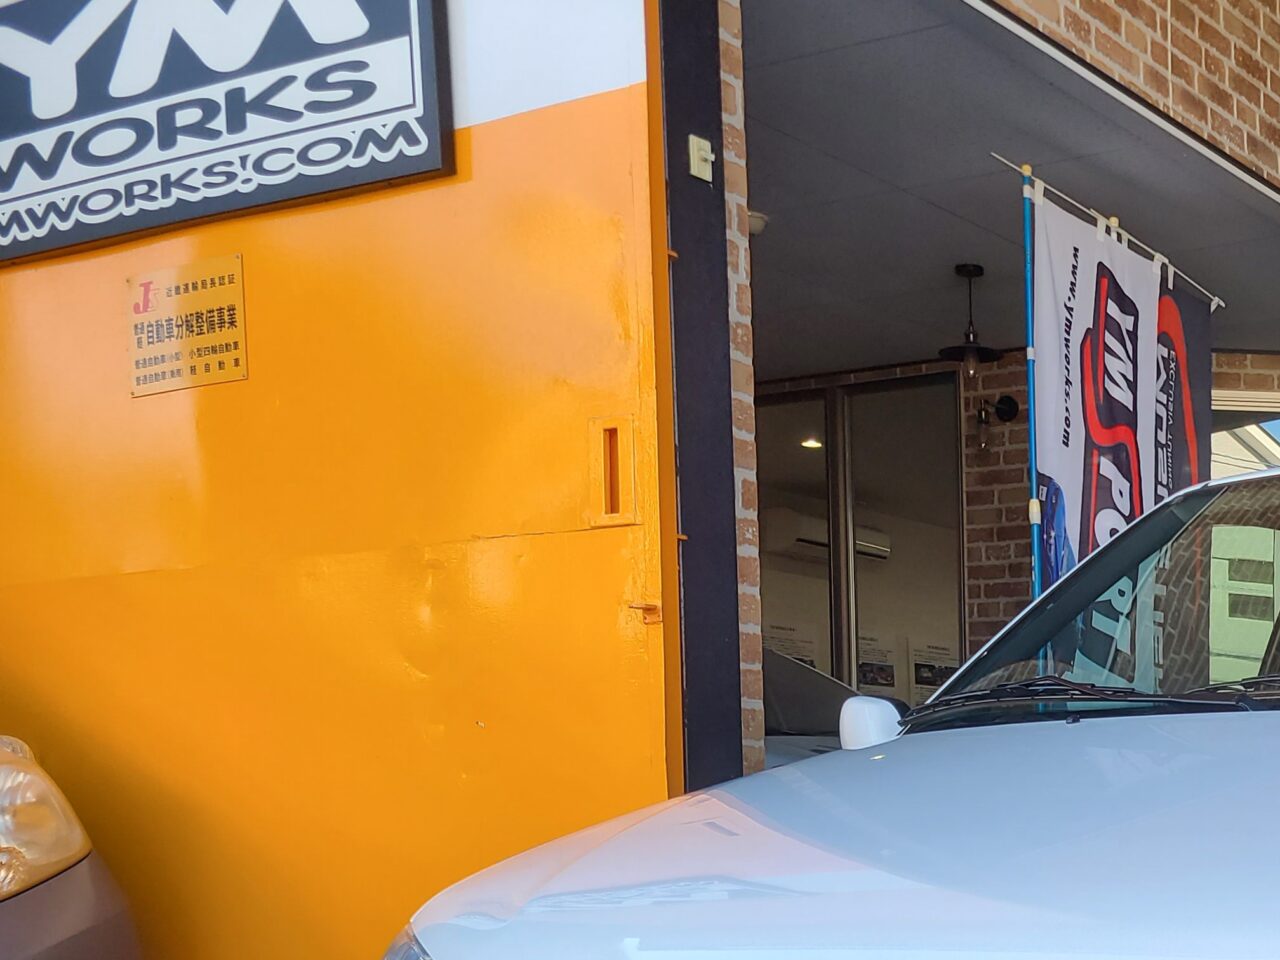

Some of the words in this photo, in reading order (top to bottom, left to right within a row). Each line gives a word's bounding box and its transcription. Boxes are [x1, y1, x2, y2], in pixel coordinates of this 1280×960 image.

[0, 60, 377, 192] WORKS
[146, 304, 238, 345] 自動車分解整備事業
[1062, 246, 1080, 448] www.ymworks.com
[1104, 297, 1135, 413] YM
